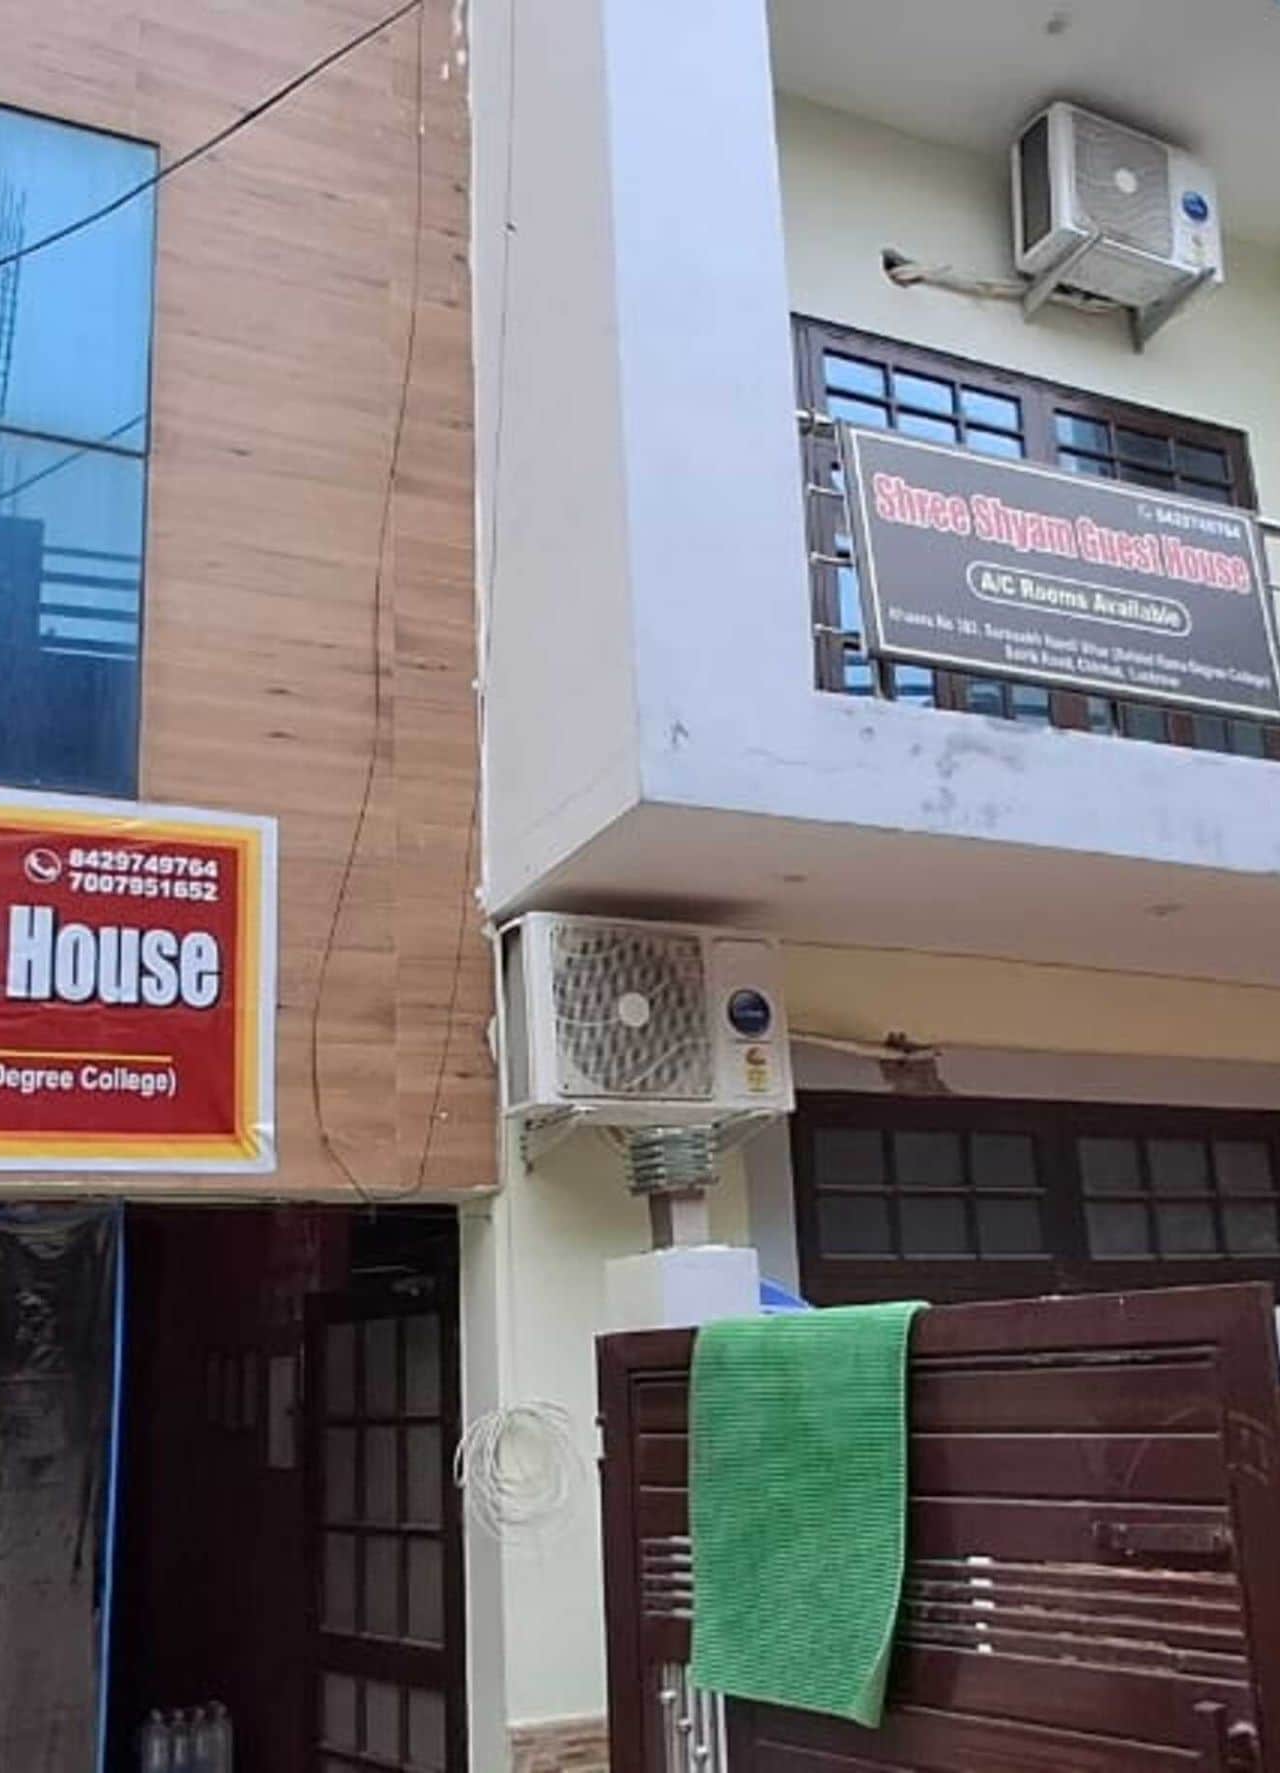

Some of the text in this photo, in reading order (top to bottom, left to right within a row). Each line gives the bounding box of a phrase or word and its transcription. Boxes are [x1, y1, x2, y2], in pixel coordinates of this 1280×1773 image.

[873, 472, 1252, 595] Shree Shyam Guest House
[980, 571, 1182, 626] A/C Rooms Available
[68, 848, 219, 878] 8429749764
[68, 871, 220, 901] 7007951652
[6, 905, 221, 1009] House
[80, 1066, 177, 1097] College)
